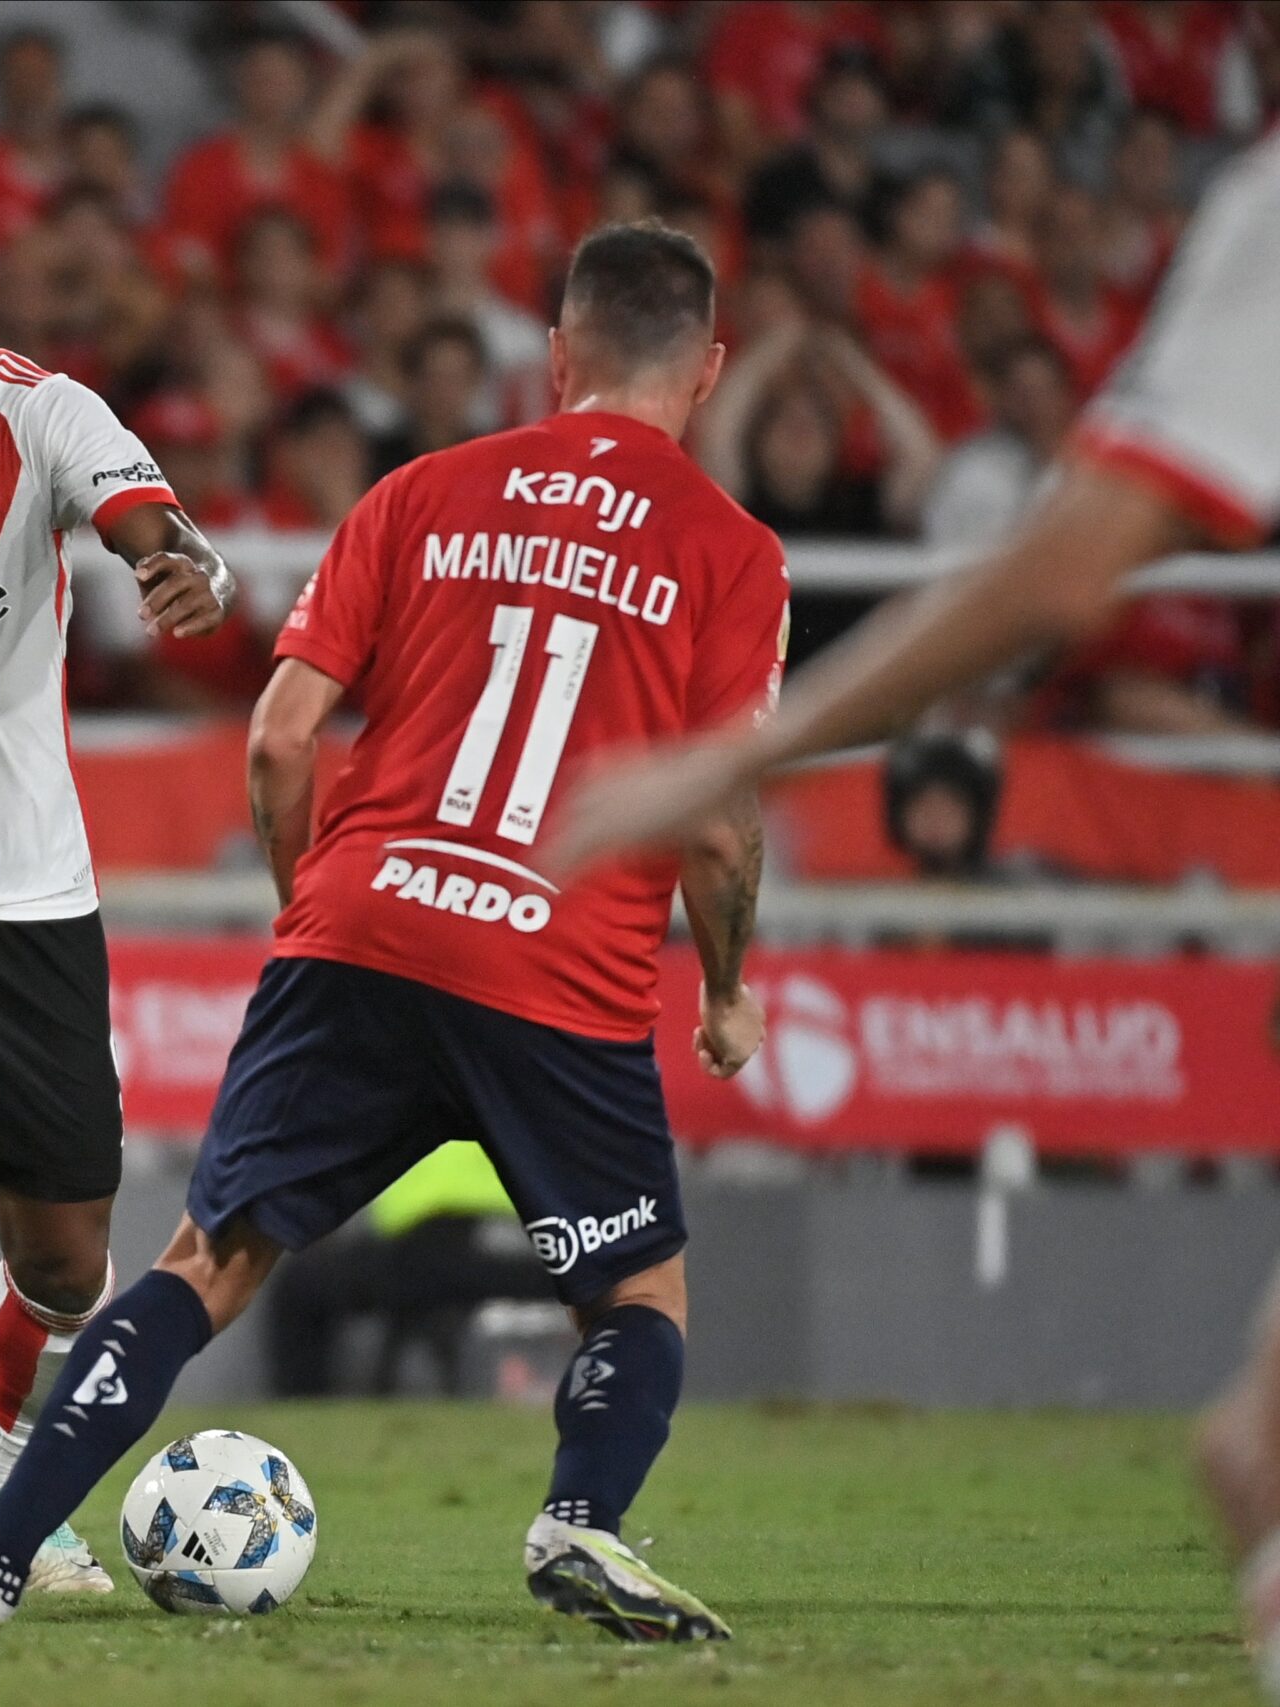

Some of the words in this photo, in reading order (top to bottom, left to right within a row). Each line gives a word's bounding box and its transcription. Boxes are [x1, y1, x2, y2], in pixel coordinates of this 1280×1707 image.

[422, 532, 679, 626] MANCUELLO
[437, 603, 600, 846] 11
[506, 812, 534, 830] RUS
[370, 855, 552, 933] PARDO
[577, 1195, 657, 1253] Bank
